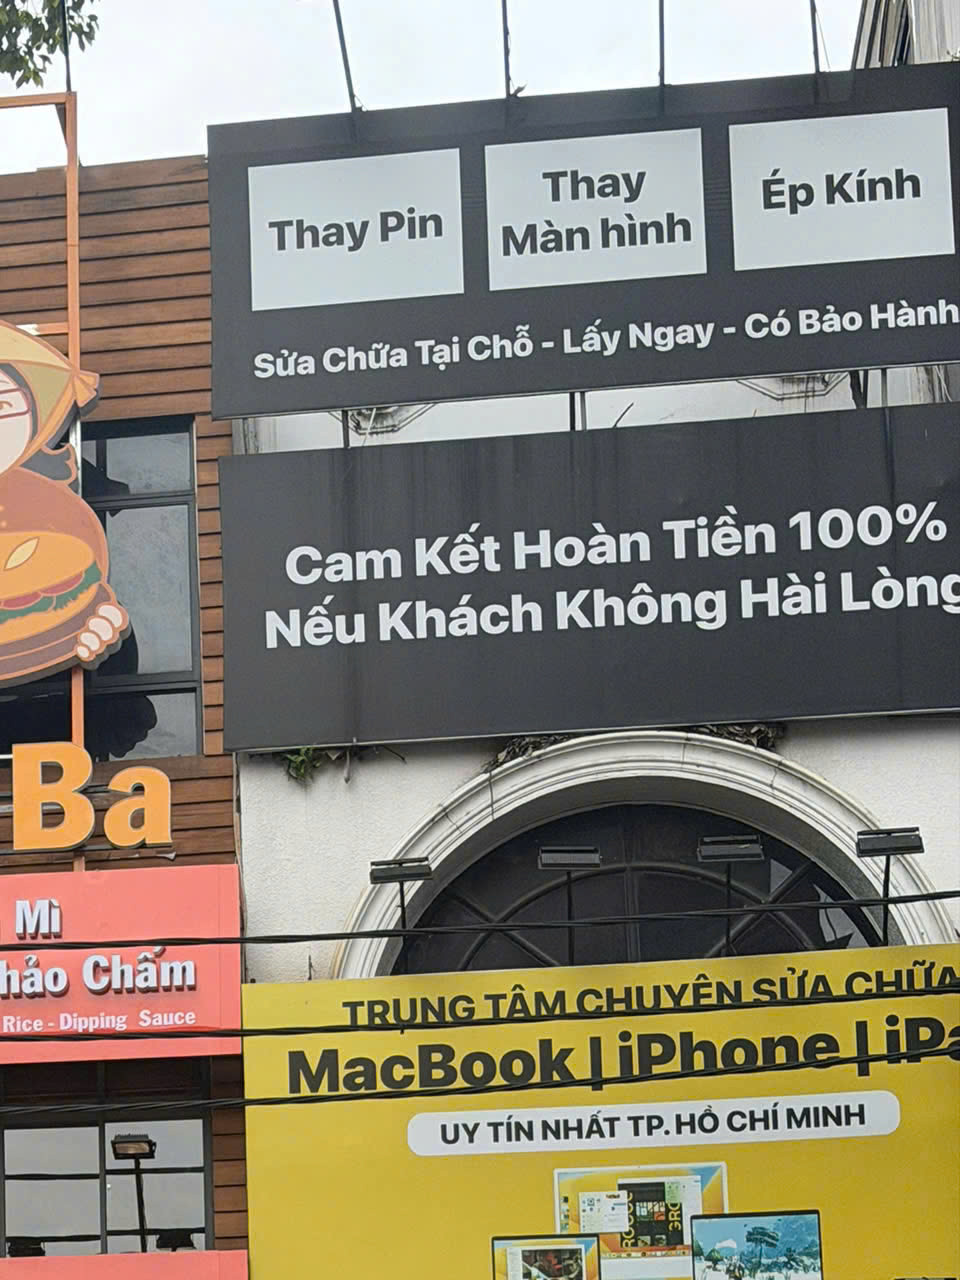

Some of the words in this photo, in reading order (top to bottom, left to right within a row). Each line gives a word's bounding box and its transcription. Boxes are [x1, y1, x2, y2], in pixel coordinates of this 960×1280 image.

[542, 169, 647, 206] Thay
[762, 169, 815, 214] Ép
[825, 167, 922, 204] Kính
[268, 216, 369, 253] Thay
[379, 207, 444, 241] Pin
[502, 219, 590, 256] Màn
[600, 211, 692, 250] hình
[253, 349, 316, 379] Sửa
[322, 343, 408, 373] Chữa
[414, 336, 460, 371] Tại
[467, 324, 533, 360] Chỗ
[563, 319, 620, 356] Lấy
[629, 322, 714, 351] Ngay
[745, 308, 791, 338] Có
[799, 305, 862, 335] Bảo
[870, 299, 959, 329] Hành
[285, 546, 402, 586] Cam
[415, 525, 501, 576] Kết
[513, 523, 651, 571] Hoàn
[663, 506, 776, 560] Tiền
[789, 502, 946, 551] 100%
[265, 590, 366, 649] Nếu
[380, 594, 543, 642] Khách
[556, 584, 727, 630] Không
[740, 575, 828, 619] Hài
[12, 741, 173, 850] Ba
[15, 899, 62, 939] Mì
[82, 945, 197, 996] Chấm
[2, 1015, 43, 1032] Rice
[59, 1012, 128, 1032] Dipping
[139, 1009, 196, 1027] Sauce
[342, 997, 475, 1029] TRUNG
[484, 984, 566, 1020] TÂM
[576, 973, 742, 1017] CHUYÊN
[752, 967, 833, 1002] SỬA
[287, 1036, 576, 1095] MacBook
[618, 1029, 840, 1079] iPhone
[440, 1122, 480, 1145] UY
[487, 1115, 534, 1143] TÍN
[541, 1111, 620, 1141] NHẤT
[727, 1102, 779, 1132] CHÍ
[786, 1103, 866, 1129] MINH
